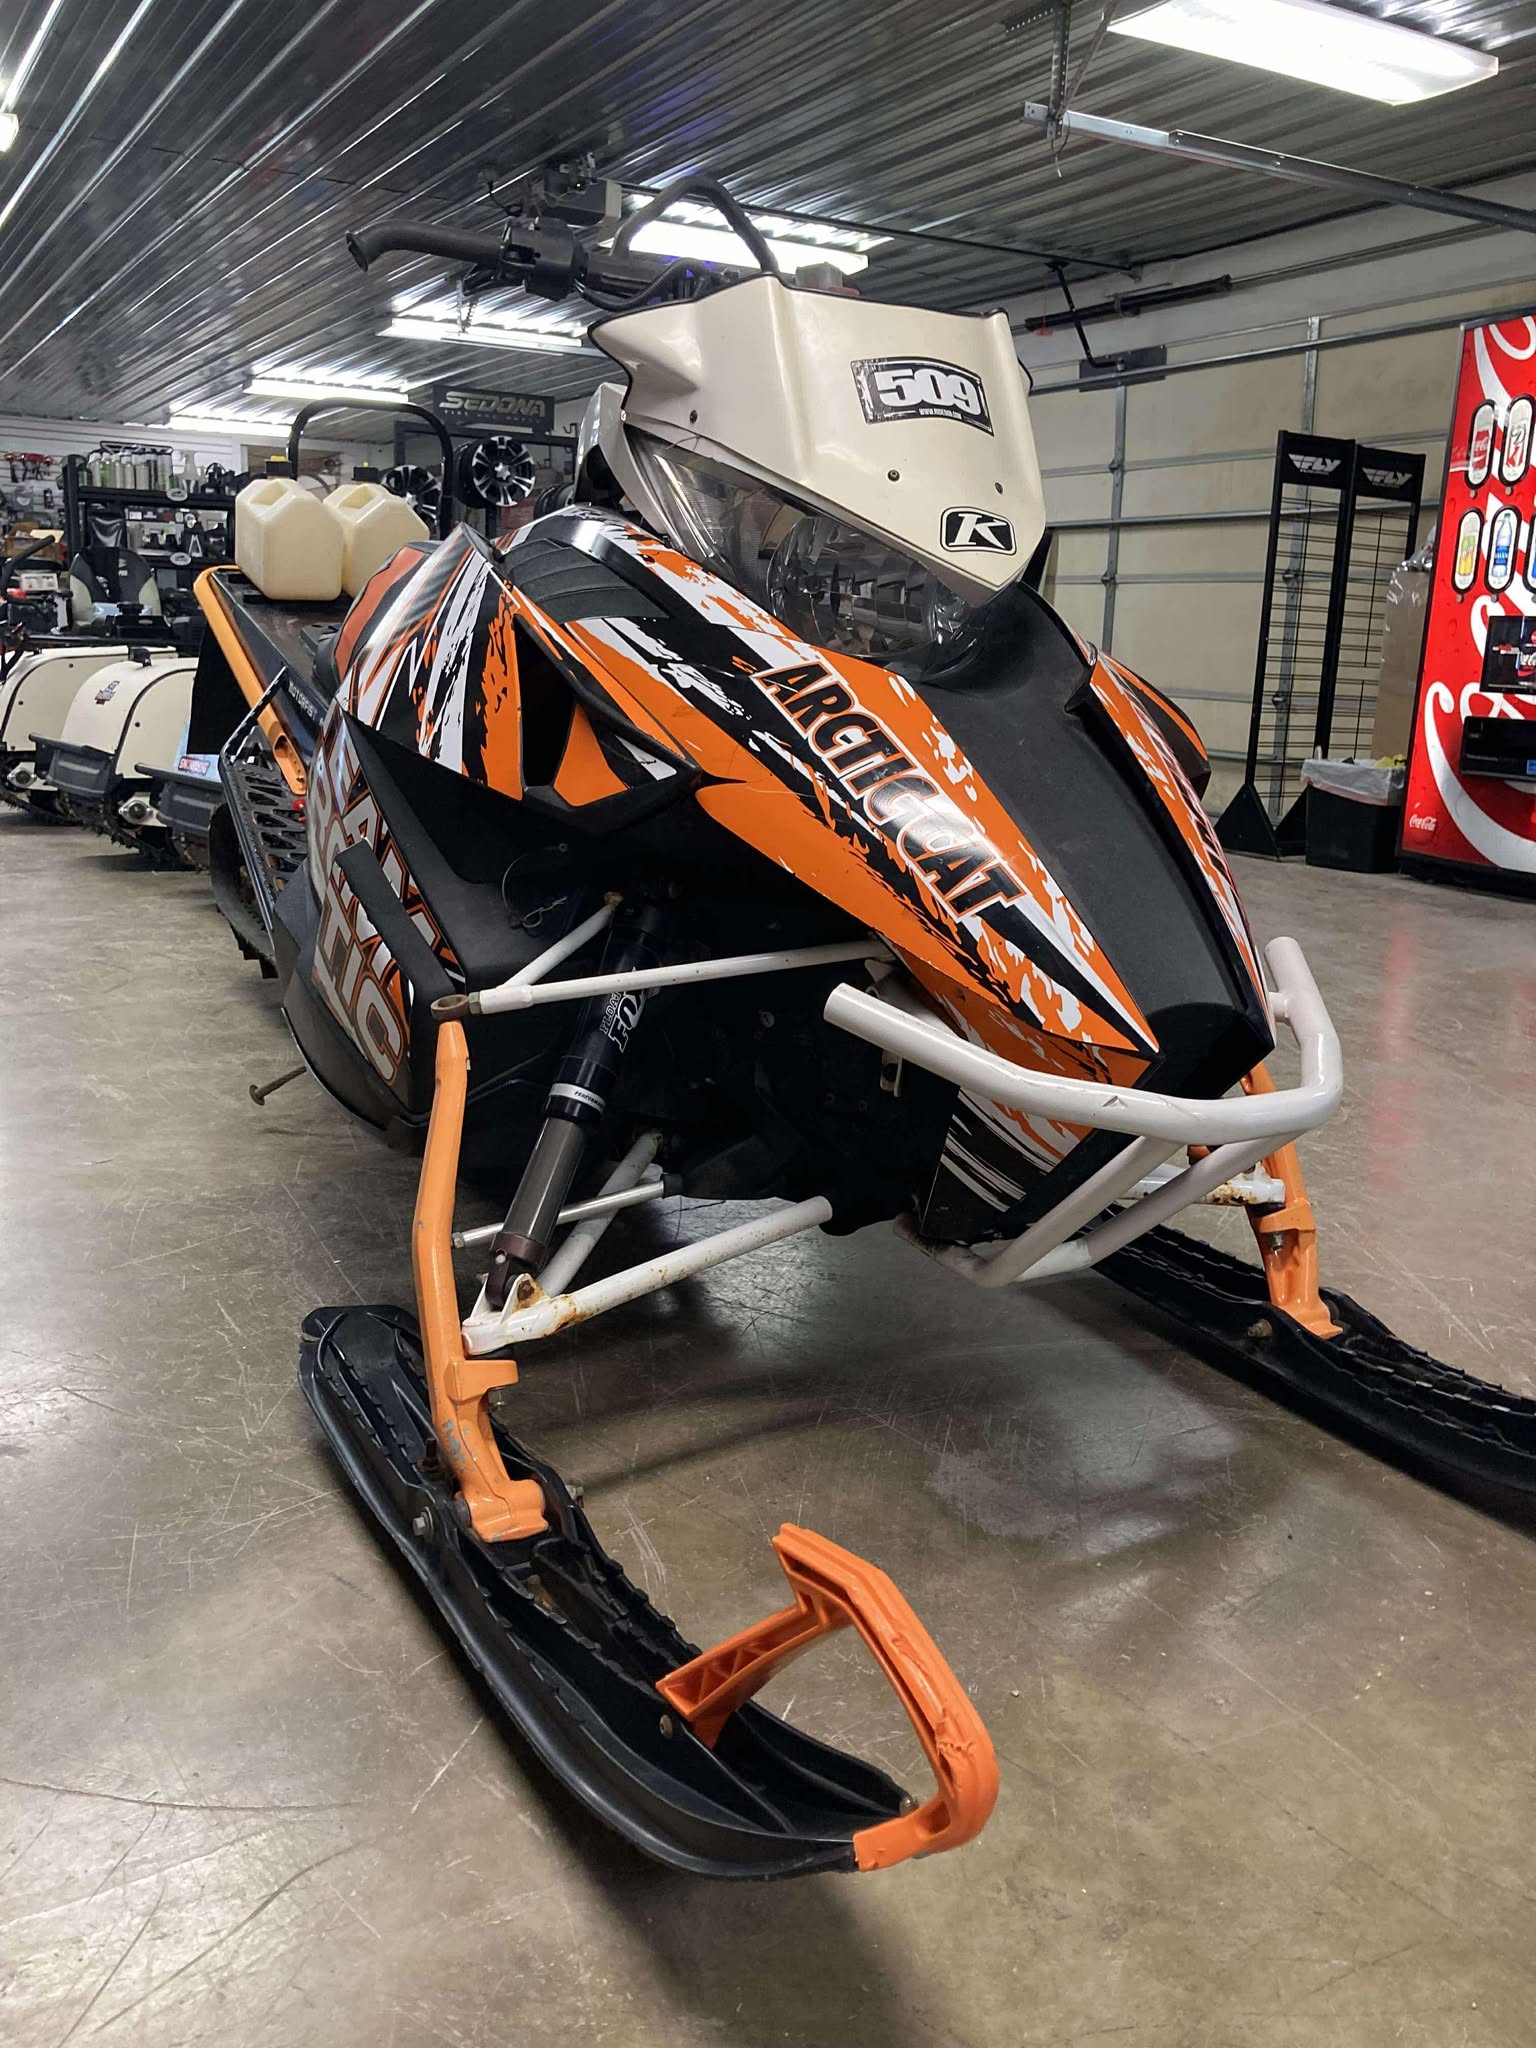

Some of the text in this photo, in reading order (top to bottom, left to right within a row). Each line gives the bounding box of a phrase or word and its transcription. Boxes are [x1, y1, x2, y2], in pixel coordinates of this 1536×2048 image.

[439, 391, 546, 418] SEDONA
[874, 368, 981, 416] 509
[1288, 453, 1342, 472] FLY
[1362, 467, 1413, 486] FLY
[948, 513, 1008, 549] K
[755, 660, 1032, 920] ARCTIC CAT
